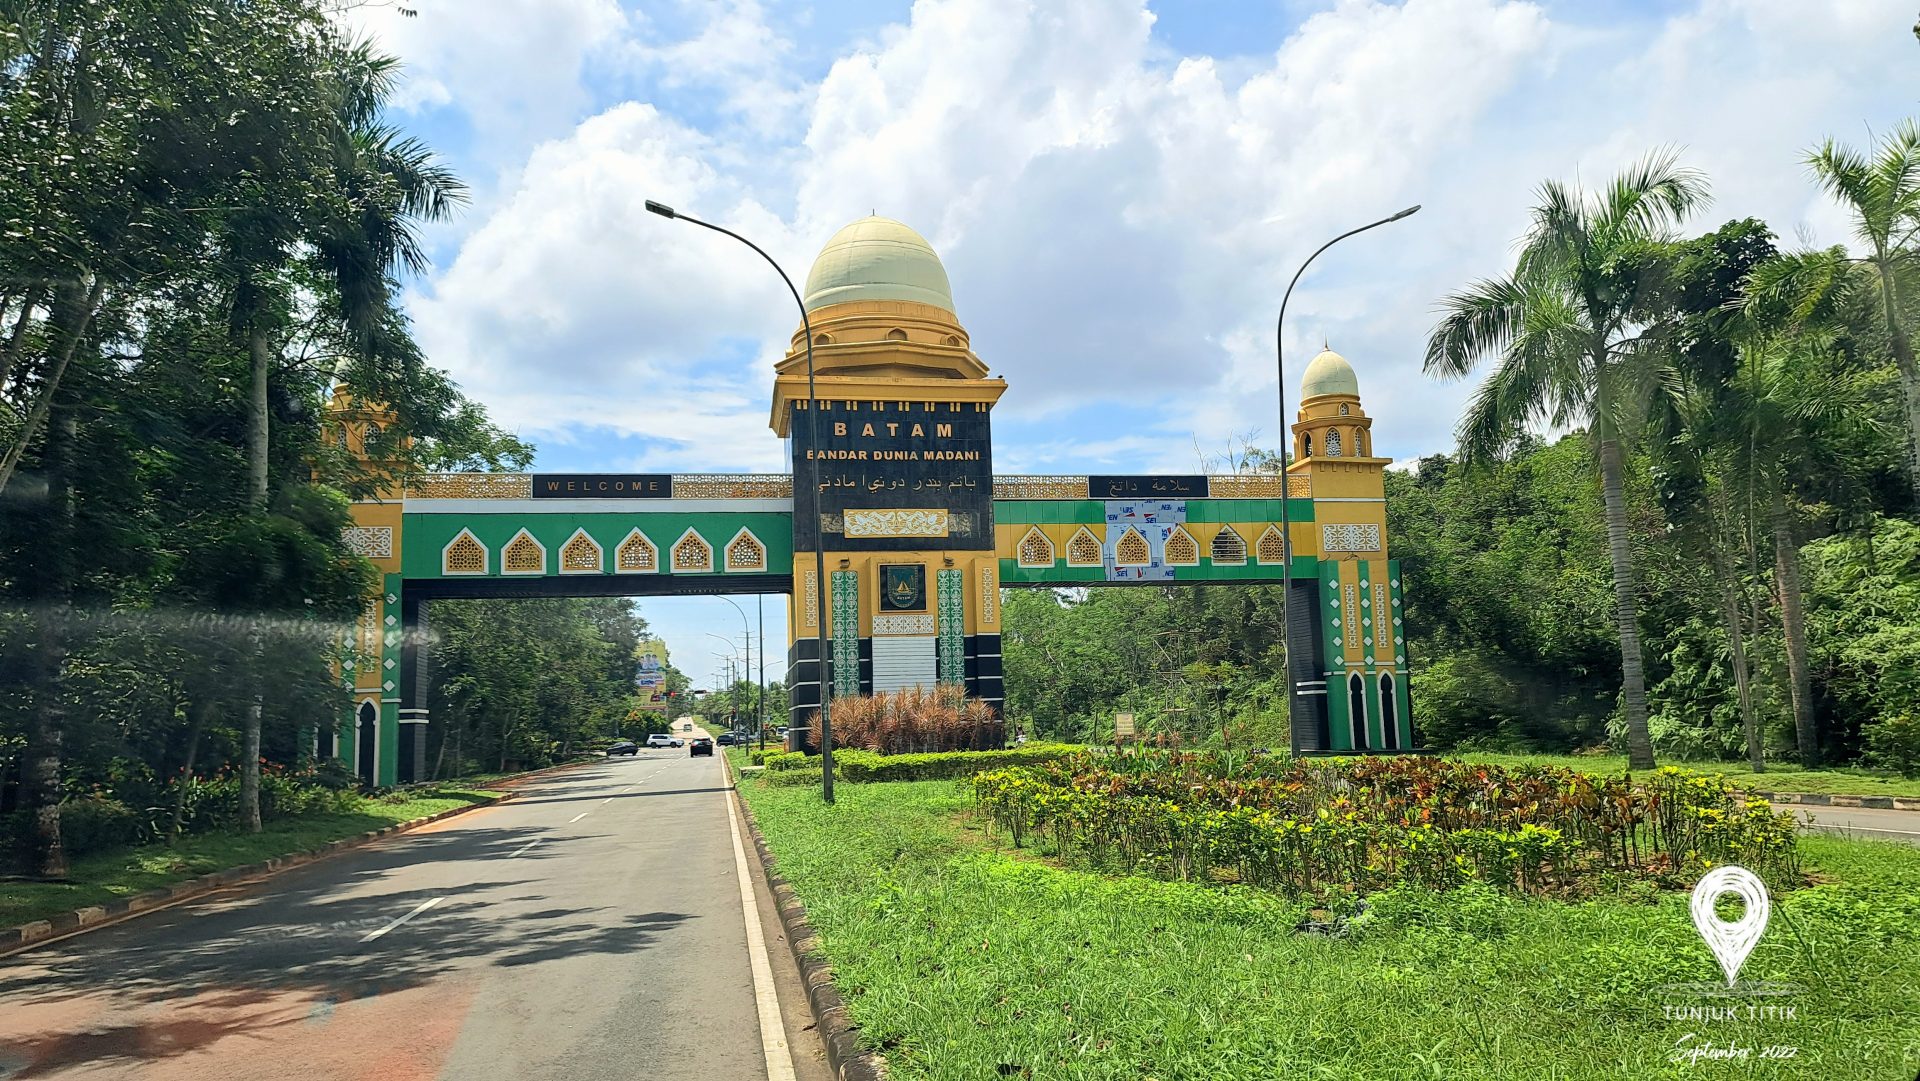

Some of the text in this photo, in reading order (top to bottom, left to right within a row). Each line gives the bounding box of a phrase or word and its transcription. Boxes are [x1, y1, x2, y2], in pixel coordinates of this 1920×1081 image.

[834, 422, 952, 437] BATAM
[806, 450, 979, 461] BANDAR DUNIA MADANI
[547, 481, 658, 491] WELCOME
